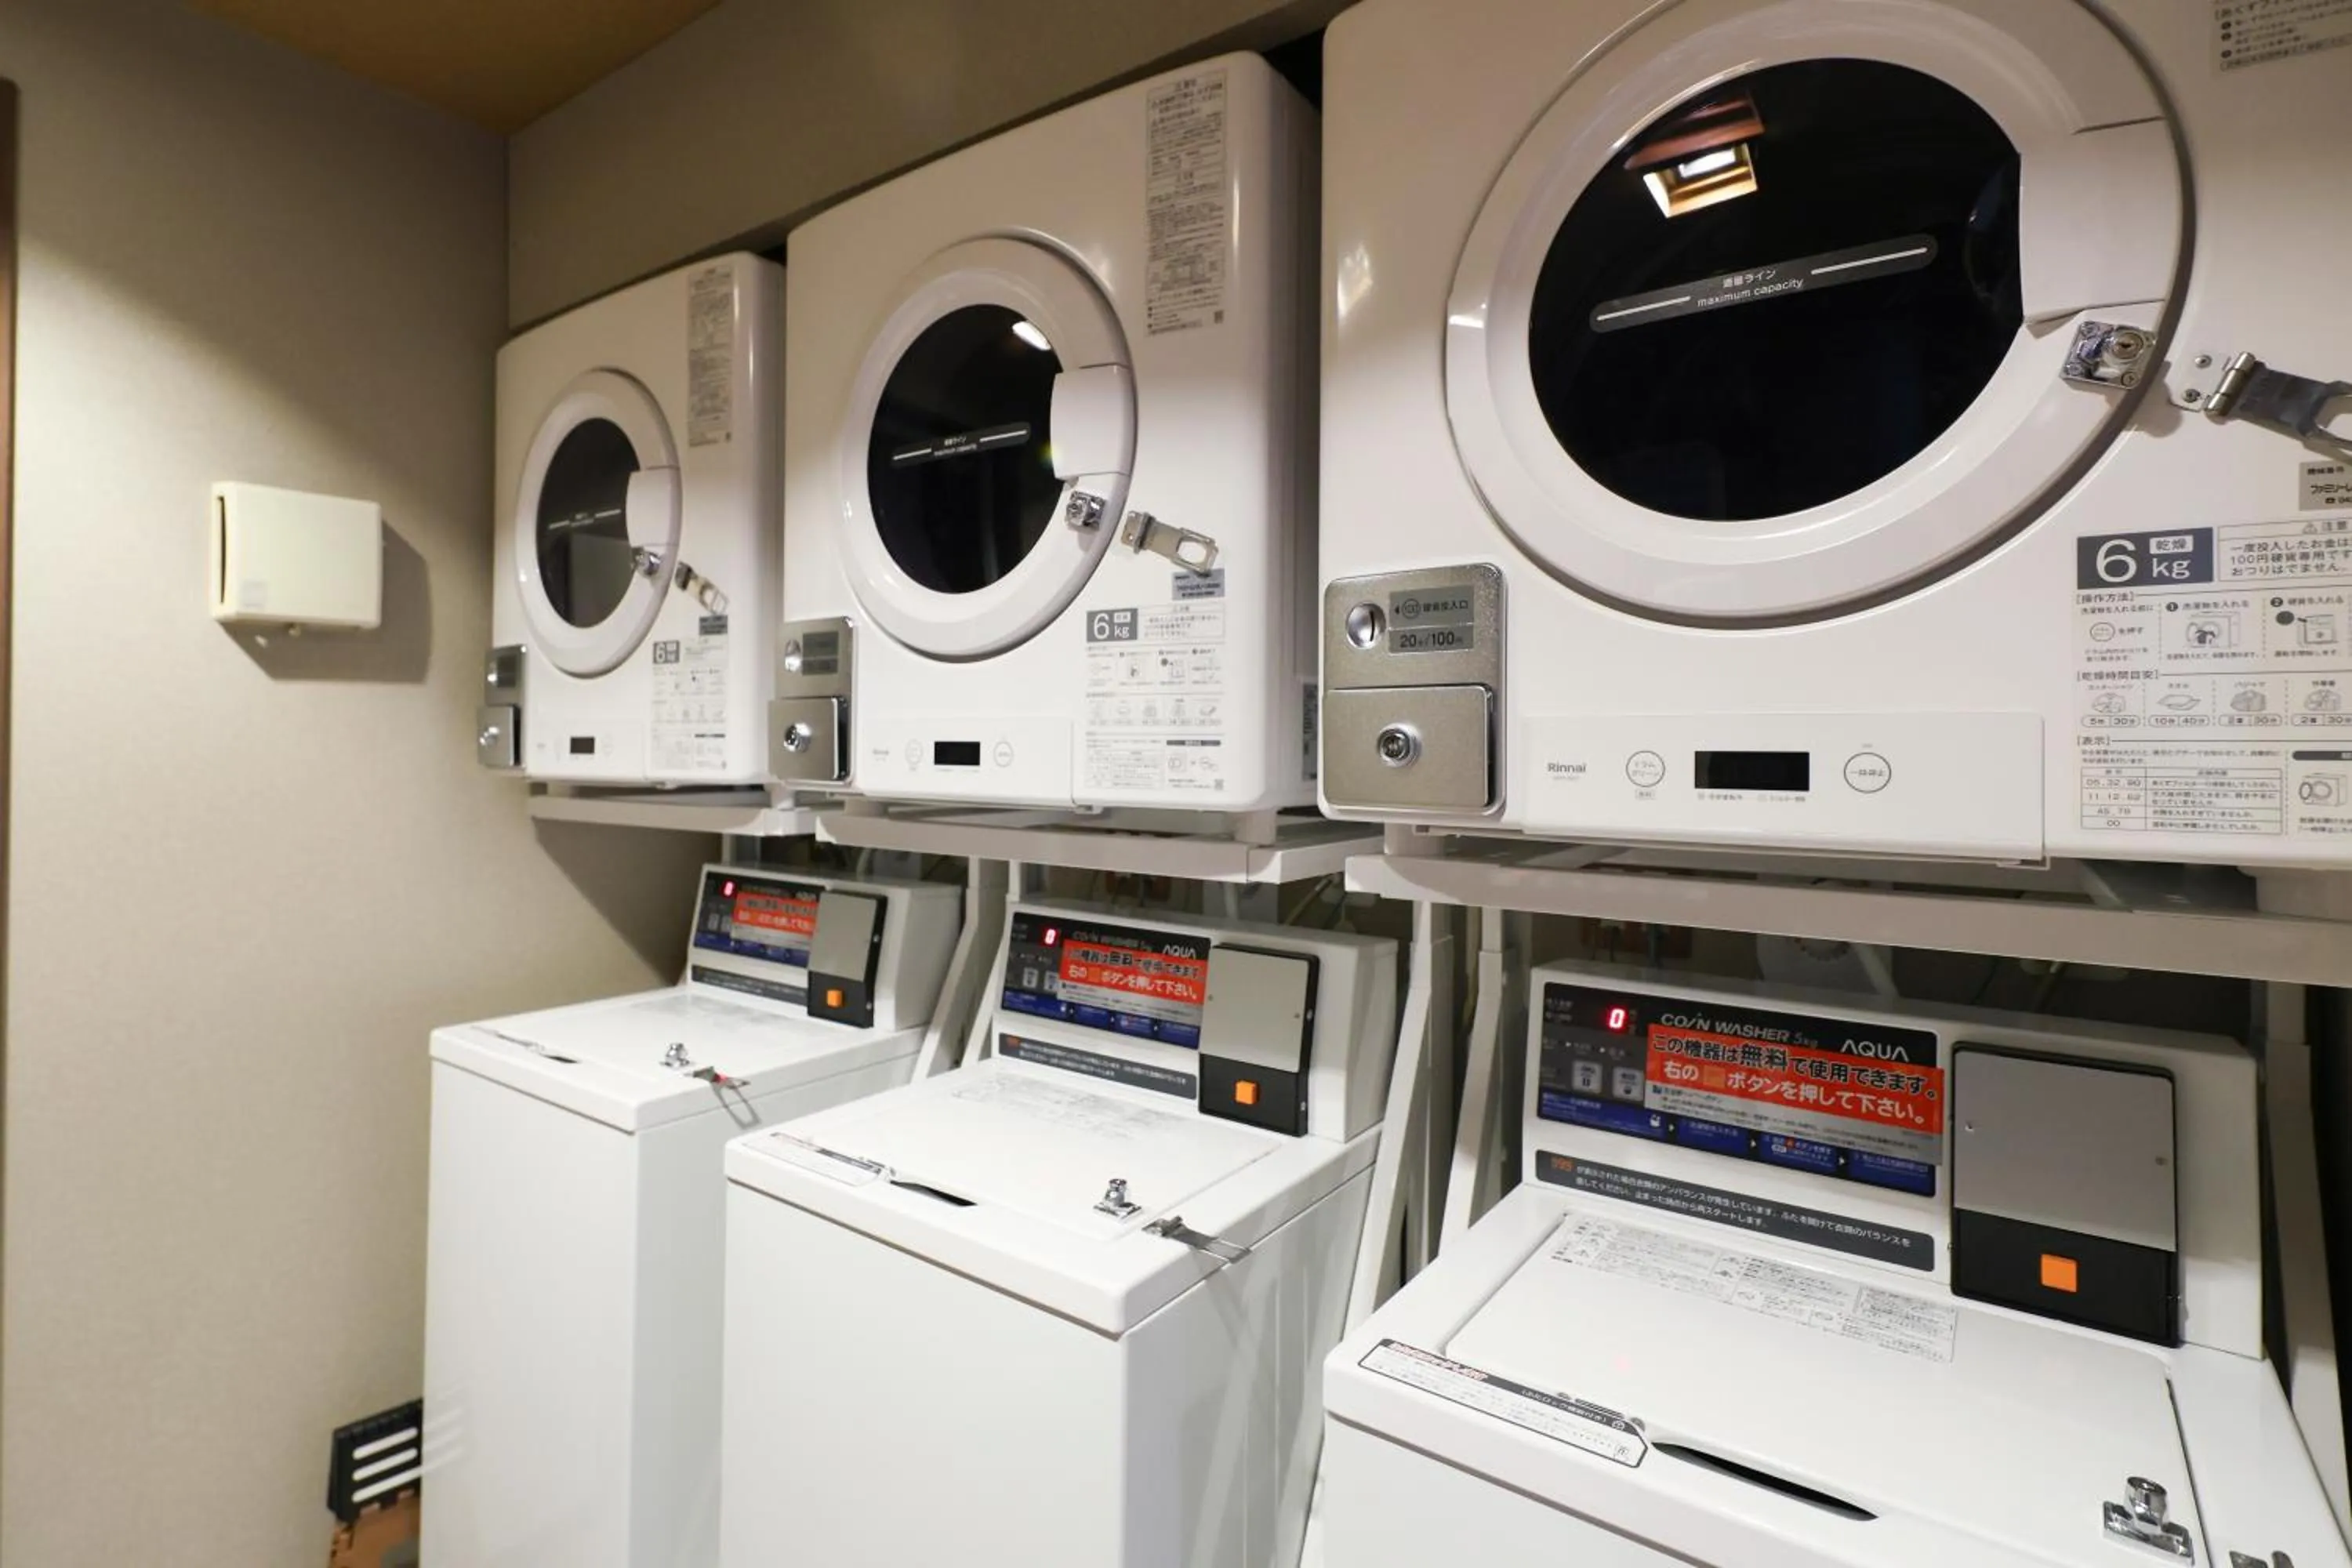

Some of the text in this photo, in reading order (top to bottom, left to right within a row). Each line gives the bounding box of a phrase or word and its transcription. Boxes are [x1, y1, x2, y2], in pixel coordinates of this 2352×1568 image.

[1697, 278, 1804, 307] maximum capacity
[2230, 538, 2352, 553] 一度投入したお金は
[2096, 539, 2138, 583] 6
[2151, 557, 2192, 580] kg
[1094, 613, 1109, 640] 6
[1548, 761, 1587, 773] Rinnai
[1162, 944, 1197, 960] AQUA
[1609, 1007, 1626, 1029] 0
[1661, 1013, 1711, 1032] COIN
[1715, 1022, 1790, 1043] WASHER
[1840, 1039, 1910, 1062] AQUA
[1653, 1034, 1936, 1101] この機器は無料で使用できます。
[1664, 1060, 1699, 1081] 右の
[1727, 1072, 1925, 1124] ボタンを押して下さい。
